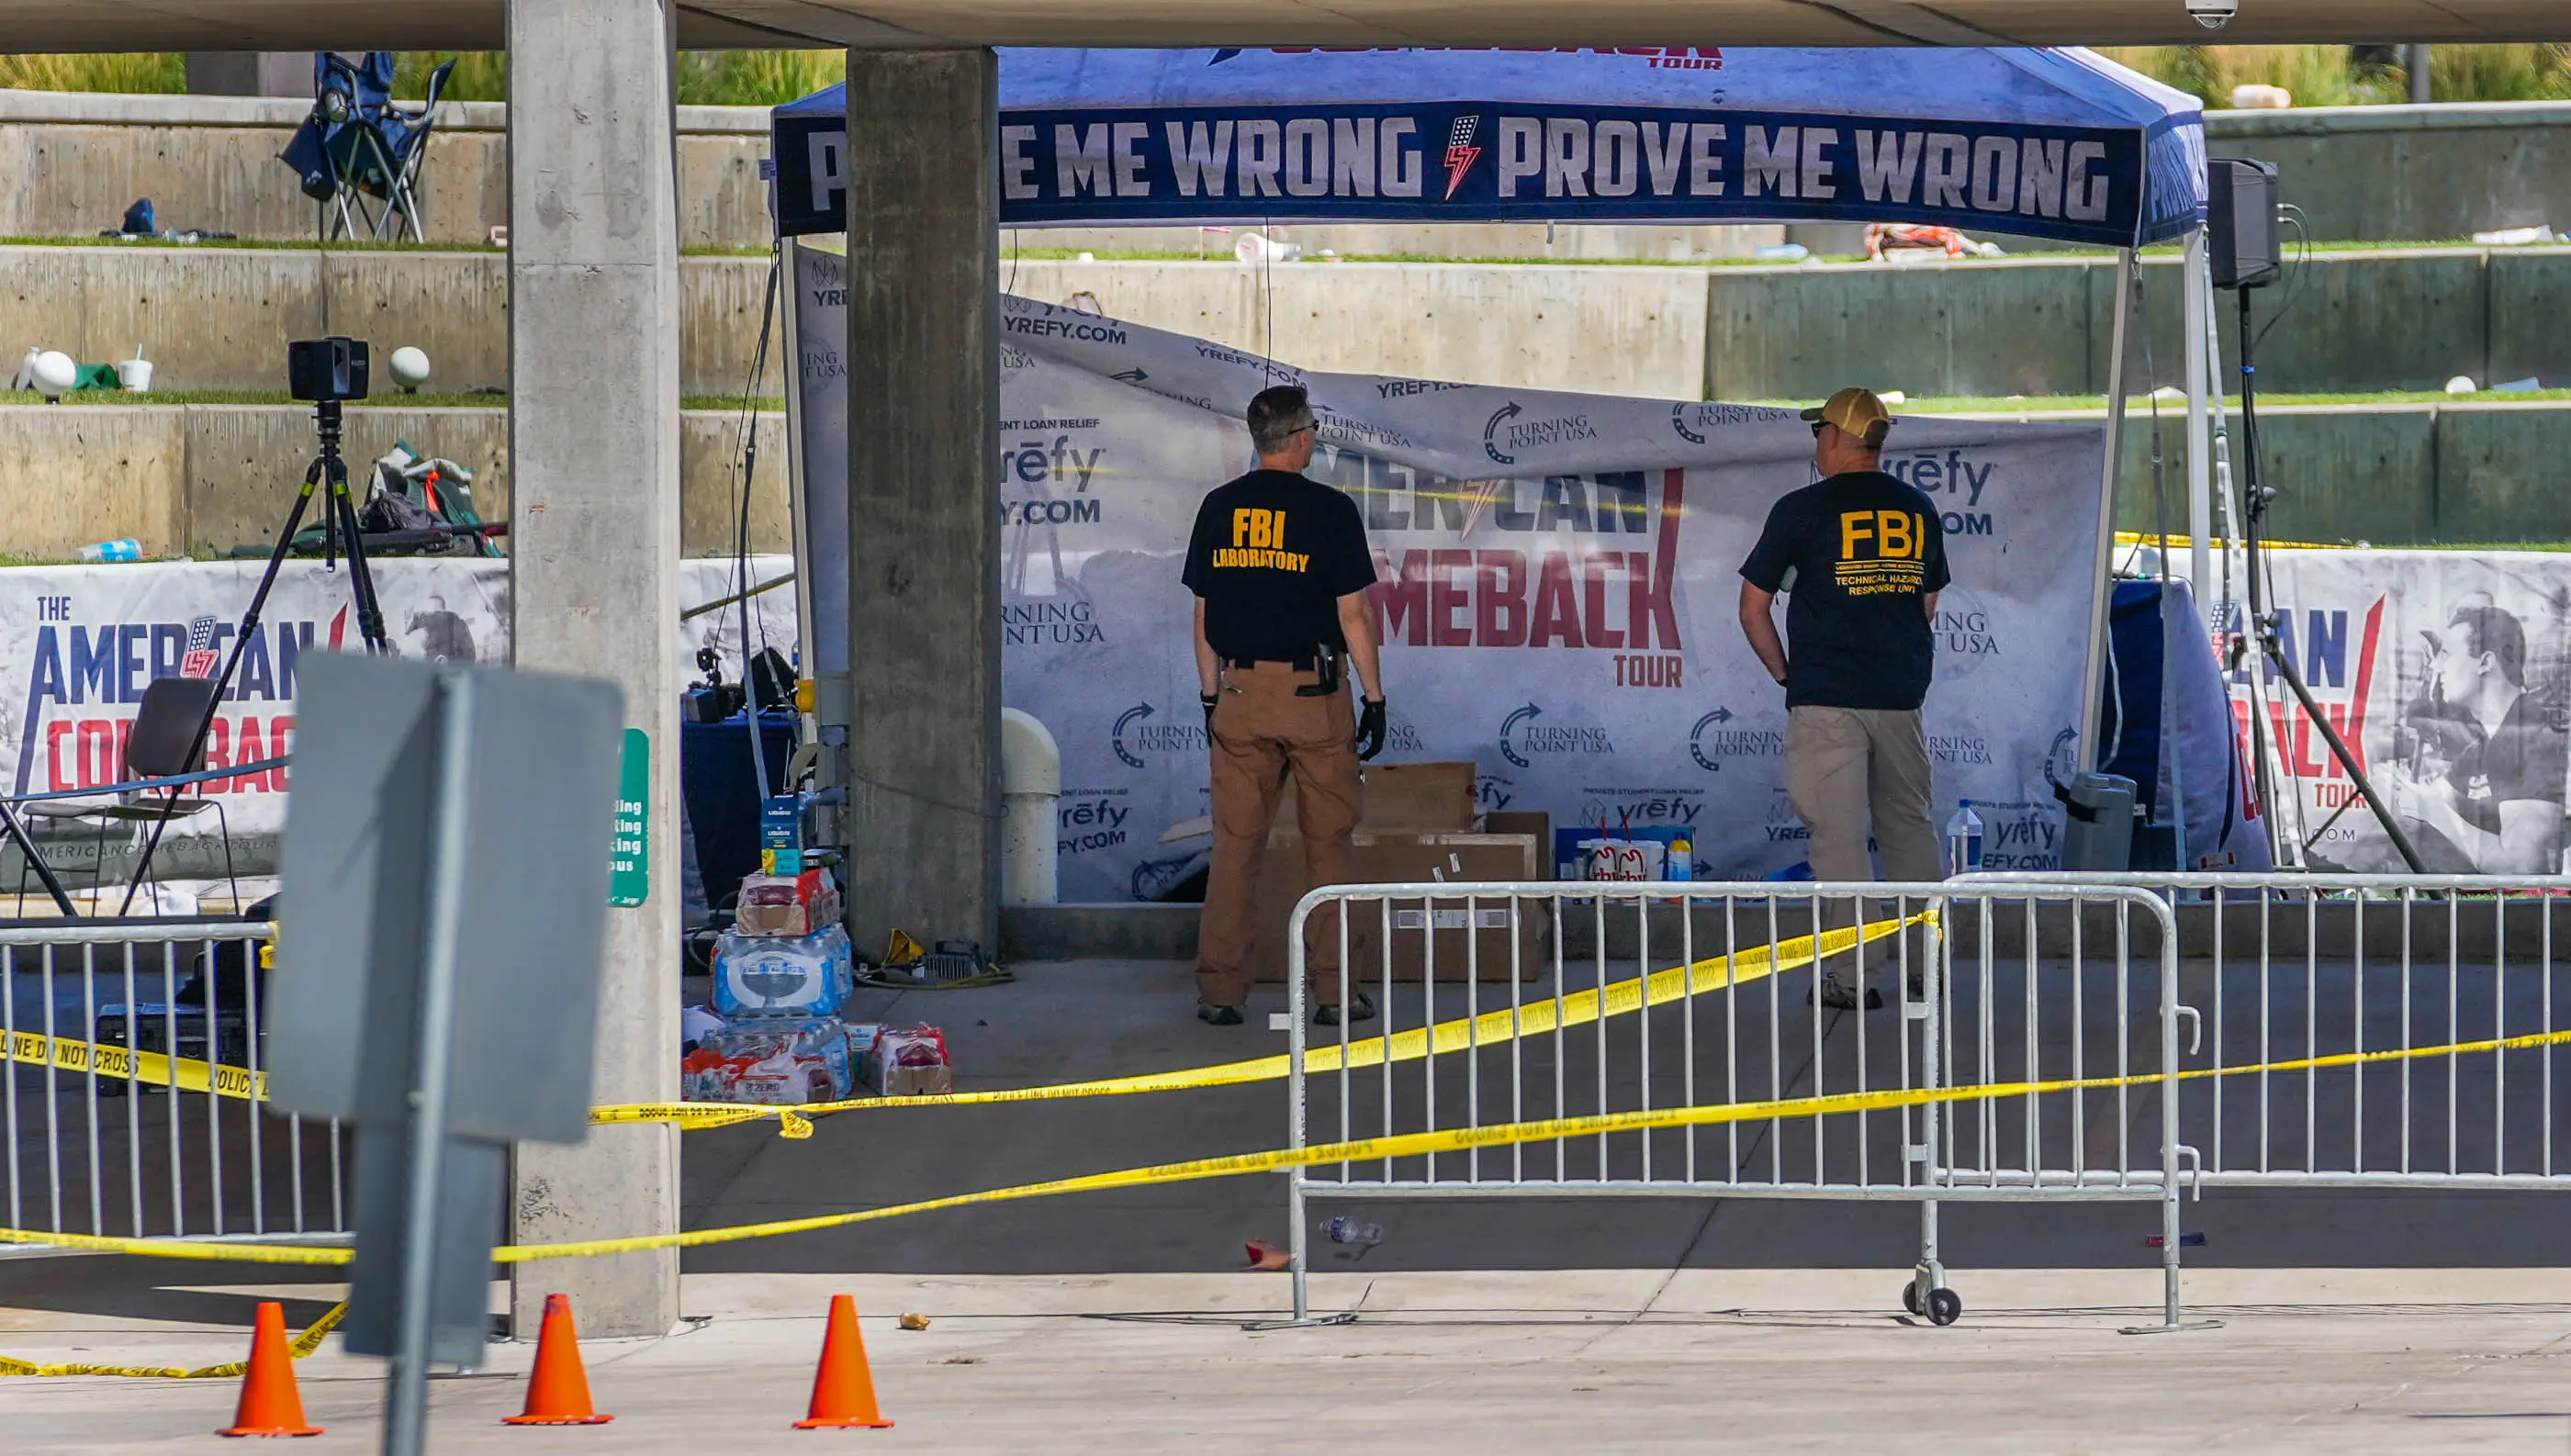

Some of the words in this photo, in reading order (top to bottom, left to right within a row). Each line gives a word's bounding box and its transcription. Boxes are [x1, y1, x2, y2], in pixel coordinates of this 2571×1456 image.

[1647, 57, 1723, 71] TOUR
[1054, 119, 1151, 197] ME
[1166, 116, 1423, 198] WRONG
[1498, 116, 1727, 198] PROVE
[1743, 124, 1838, 200] ME
[1855, 129, 2109, 222] WRONG
[1004, 315, 1127, 346] YREFY.COM
[1004, 356, 1037, 369] USA
[1023, 419, 1058, 431] LOAN
[1060, 418, 1101, 430] RELIEF
[1506, 414, 1589, 440] TURNING
[1698, 412, 1750, 427] POINT
[1757, 410, 1791, 422] USA
[1321, 426, 1375, 443] POINT
[1379, 432, 1412, 448] USA
[1509, 431, 1562, 451] POINT
[1566, 426, 1599, 442] USA
[1000, 435, 1101, 493] rēfy
[1000, 498, 1101, 526] Y.COM
[1232, 508, 1286, 550] FBI
[1840, 510, 1925, 560] FBI
[1212, 549, 1310, 573] LABORATORY
[1835, 575, 1888, 587] TECHNICAL
[1848, 583, 1896, 596] RESPONSE
[37, 596, 72, 622] THE
[1000, 601, 1091, 624] RNING
[1052, 622, 1106, 644] USA
[1949, 628, 2001, 655] USA
[1613, 655, 1682, 689] TOUR
[1138, 724, 1208, 740] TURNIN
[1524, 725, 1607, 741] TURNING
[1716, 730, 1783, 744] TURNIN
[1929, 735, 1985, 751] RNING
[1138, 738, 1194, 752] POINT
[1391, 738, 1424, 752] USA
[1523, 739, 1578, 754] POINT
[1581, 740, 1614, 754] USA
[1715, 742, 1767, 756] POINT
[1962, 750, 1993, 766] USA
[1058, 799, 1128, 828] rēfy
[1982, 853, 2059, 870] EFY.COM
[1, 1034, 31, 1058] LNE
[61, 1045, 88, 1068] NOT
